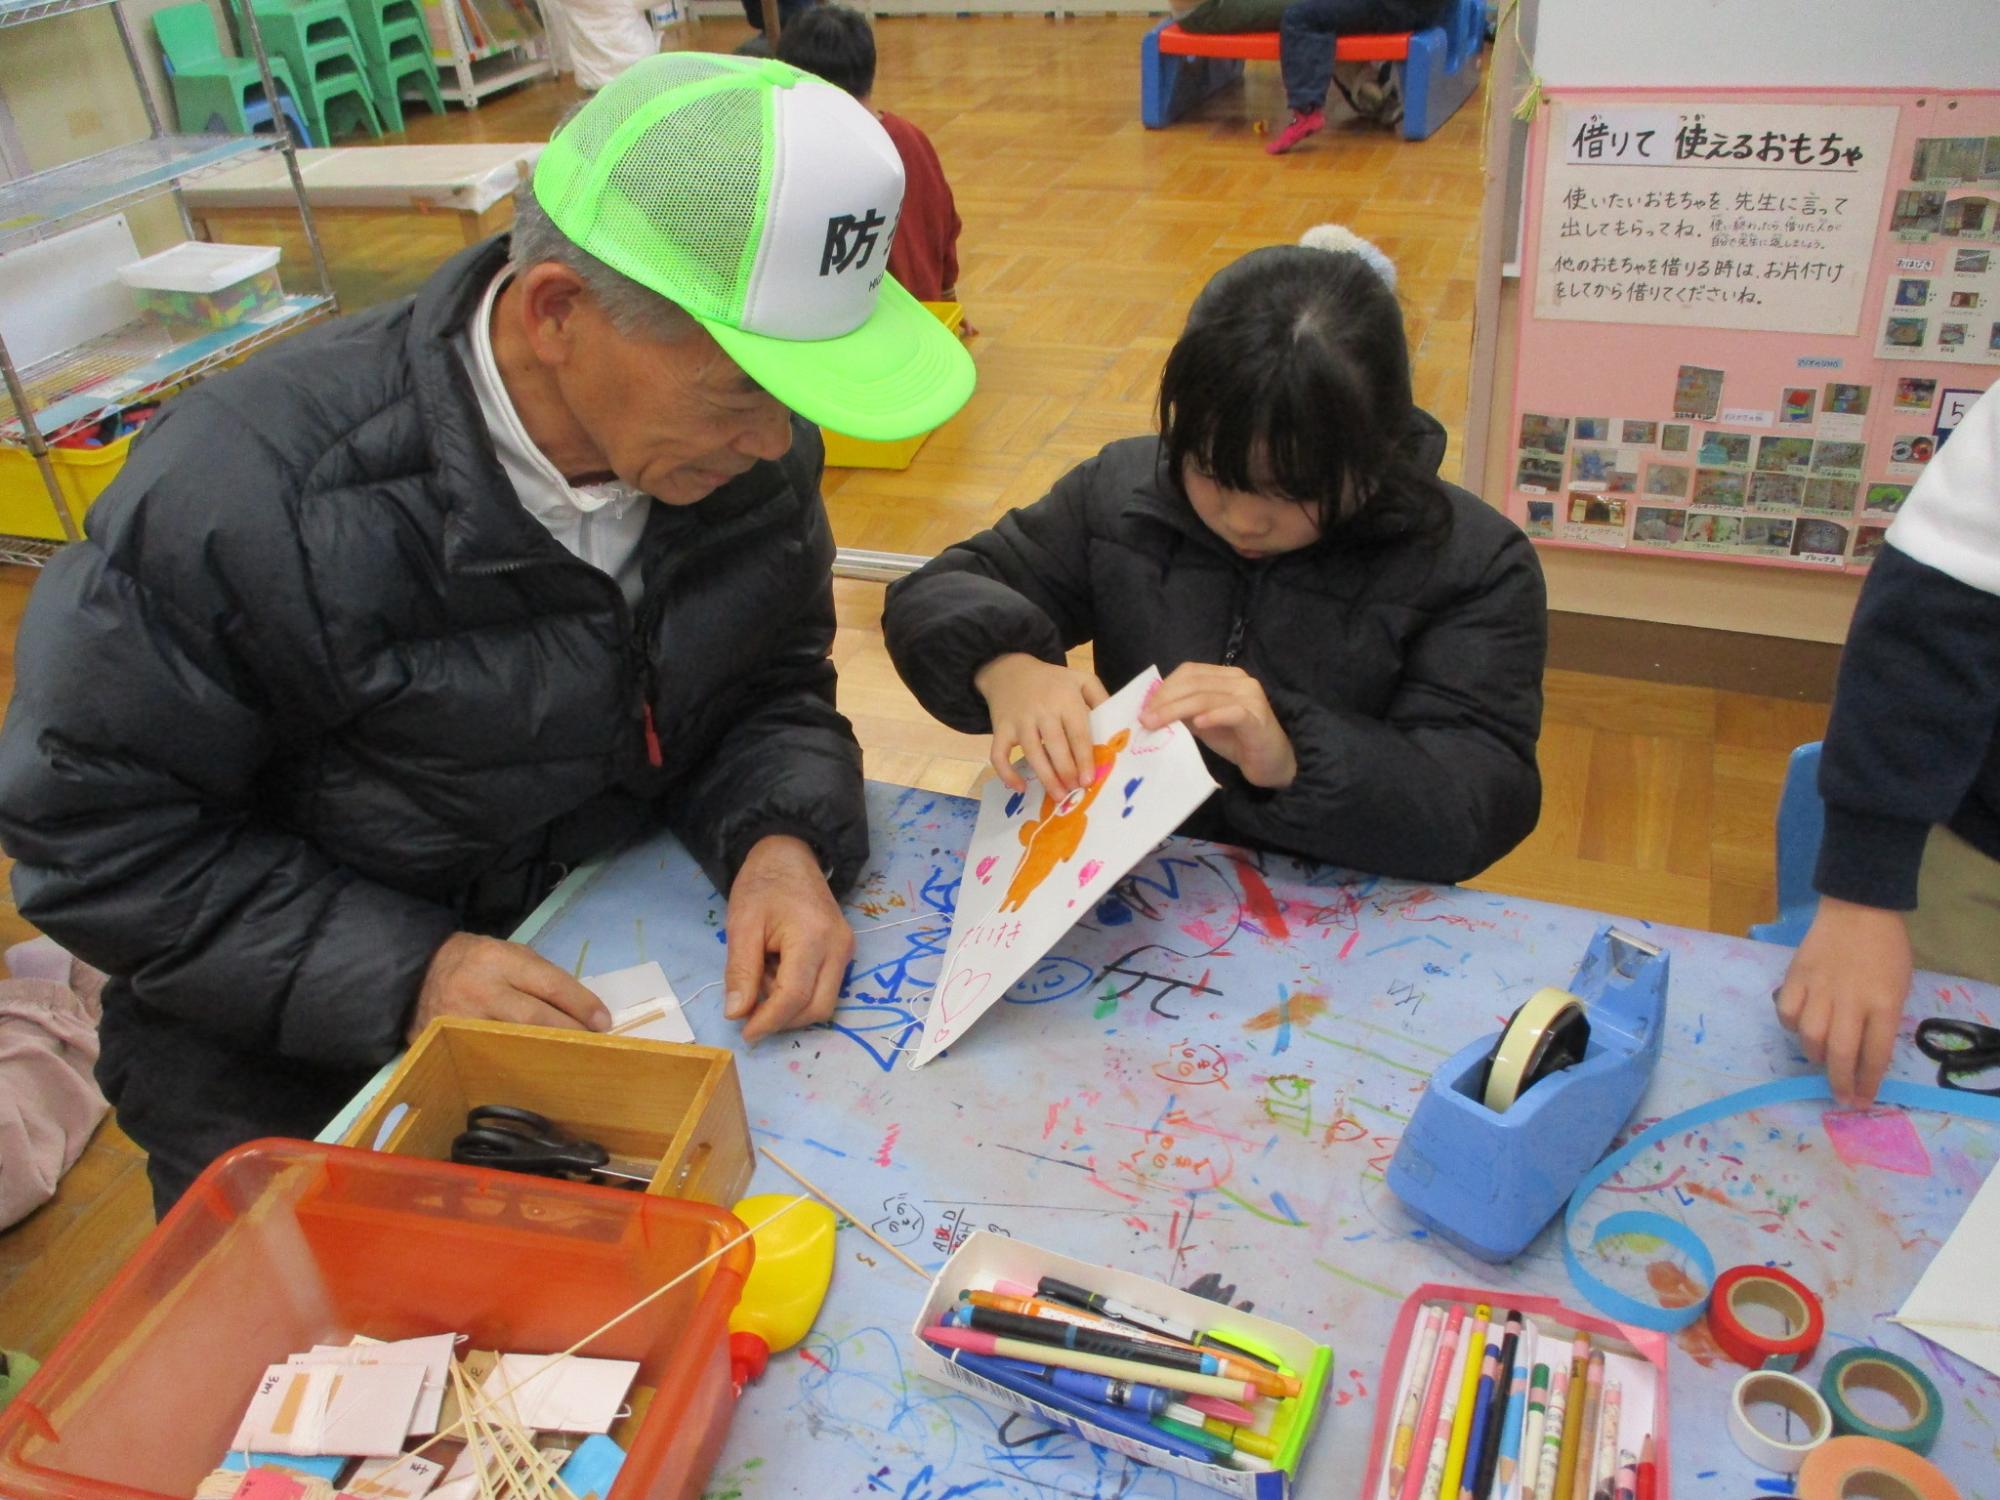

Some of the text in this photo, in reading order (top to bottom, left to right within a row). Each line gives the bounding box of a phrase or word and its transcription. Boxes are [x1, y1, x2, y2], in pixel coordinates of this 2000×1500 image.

[1572, 121, 1864, 167] 借りて 使えるおもちゃ
